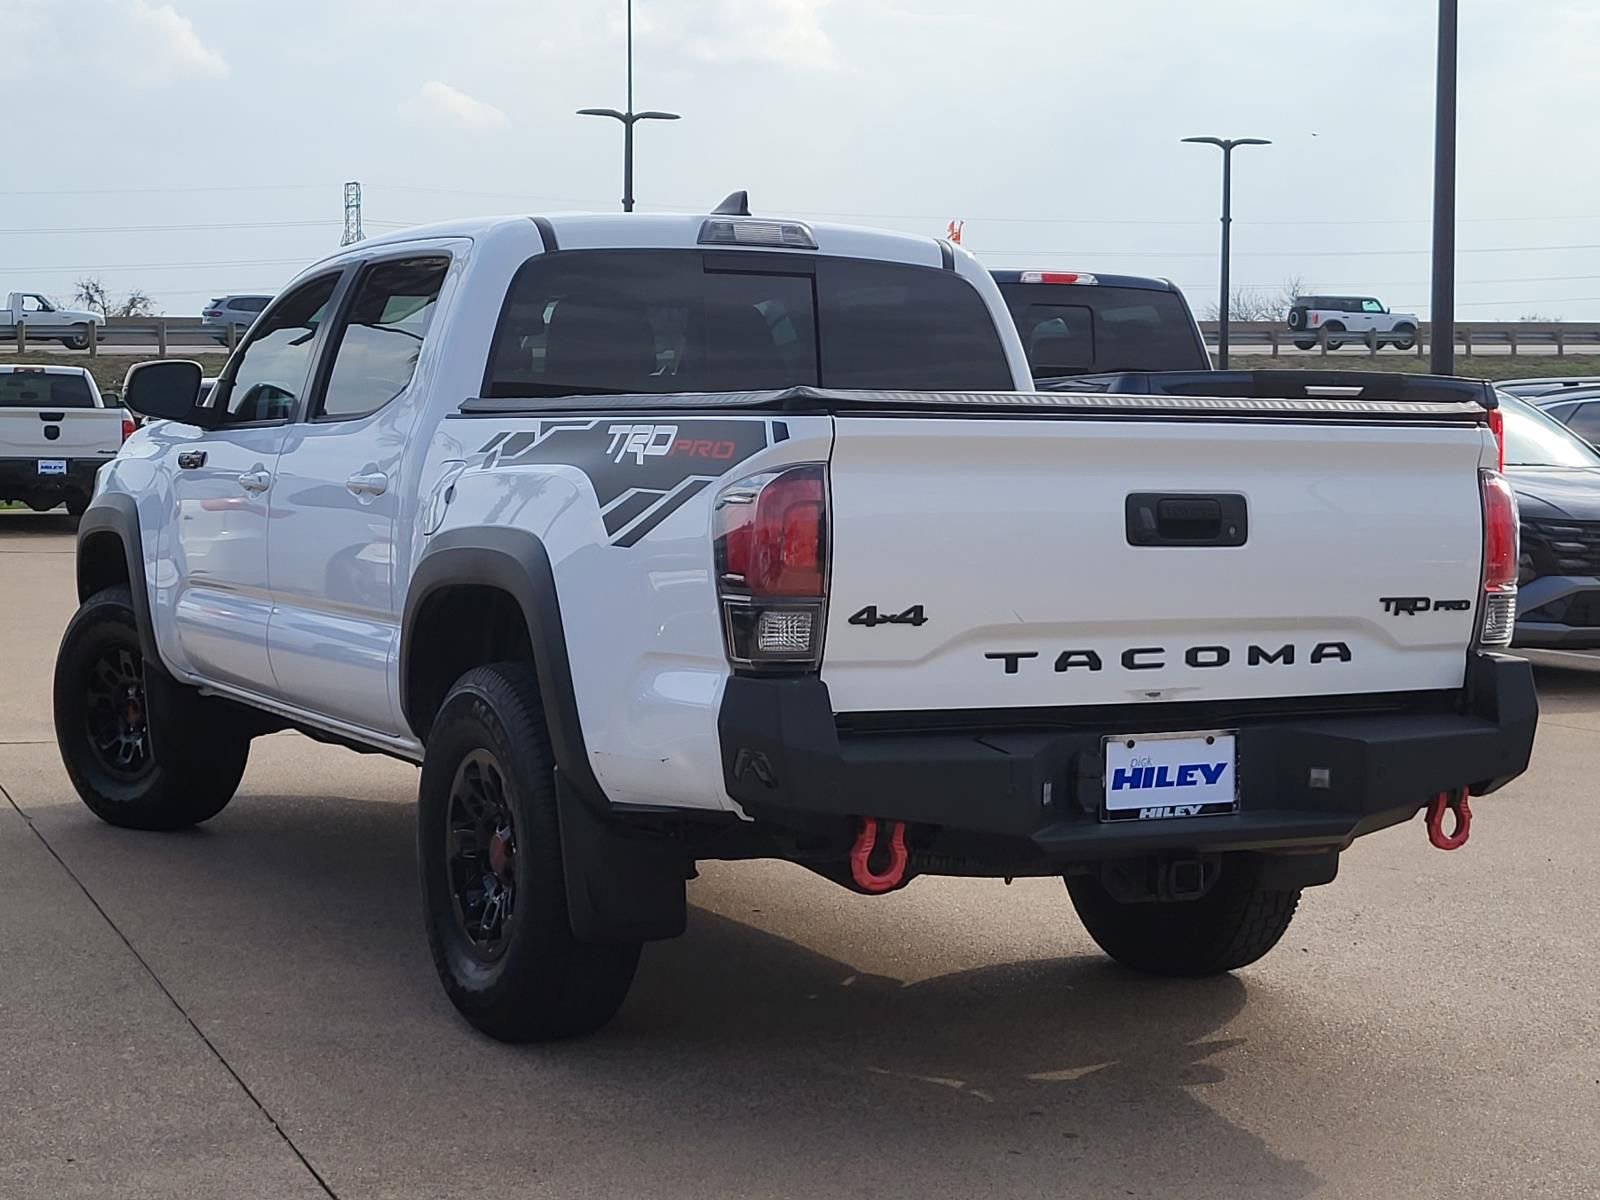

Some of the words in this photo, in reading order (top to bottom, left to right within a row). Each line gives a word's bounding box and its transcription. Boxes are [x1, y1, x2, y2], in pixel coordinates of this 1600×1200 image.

[606, 424, 678, 465] TRD
[669, 439, 736, 459] PRO
[848, 605, 928, 627] 4x4
[1379, 597, 1431, 616] TRD
[985, 641, 1352, 674] TACOMA
[1111, 763, 1228, 790] HILEY
[1139, 804, 1203, 819] HILEY
